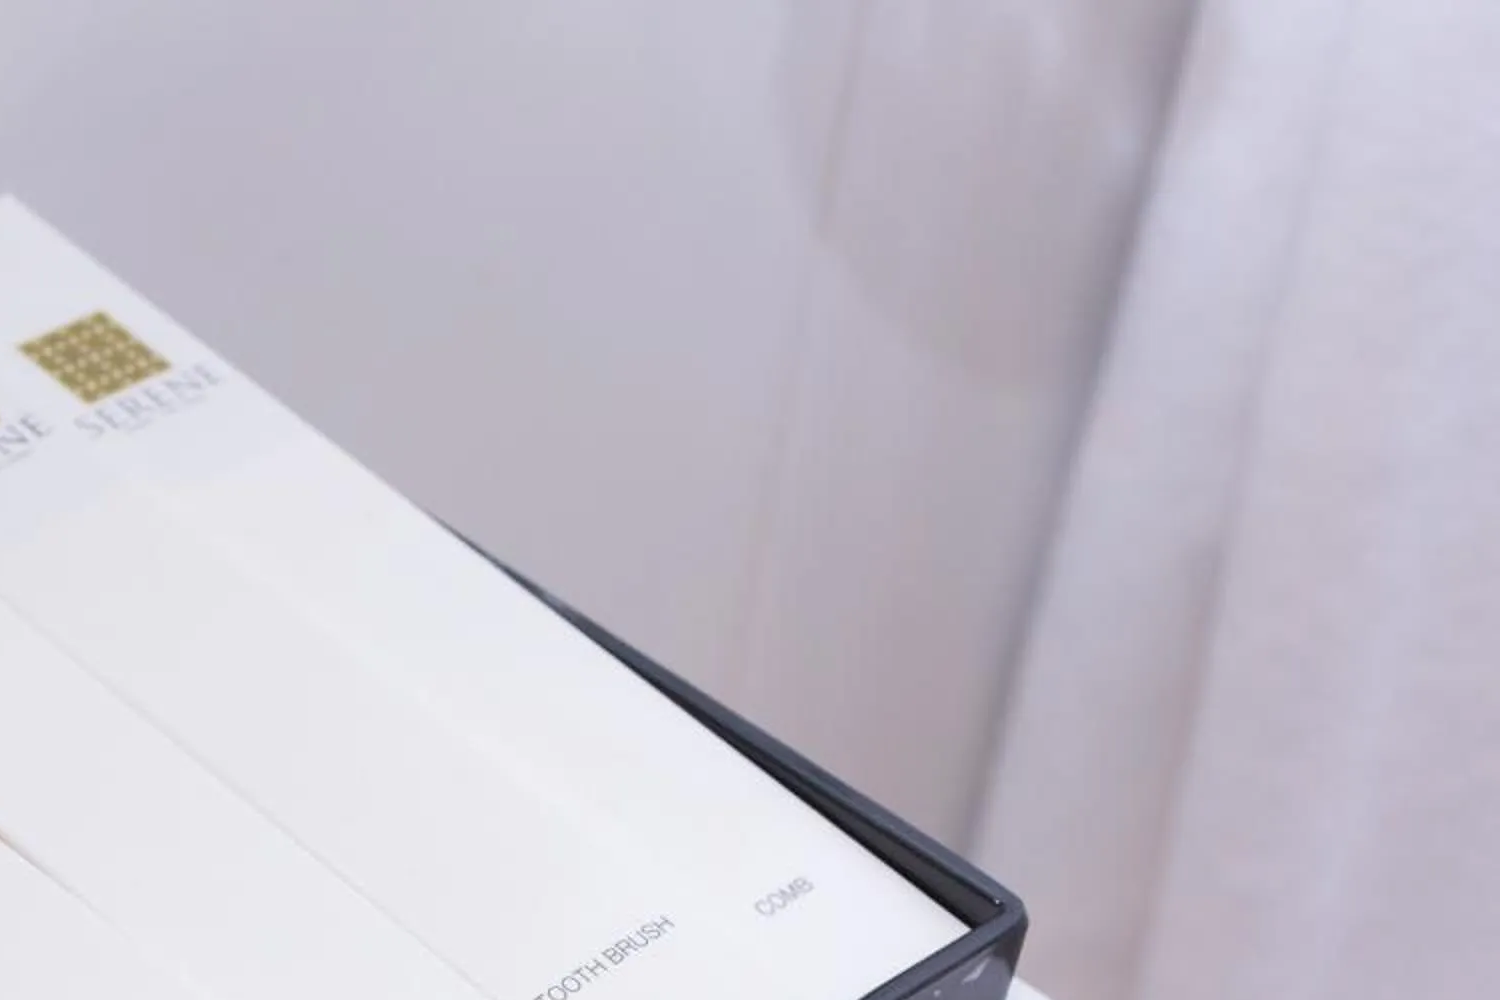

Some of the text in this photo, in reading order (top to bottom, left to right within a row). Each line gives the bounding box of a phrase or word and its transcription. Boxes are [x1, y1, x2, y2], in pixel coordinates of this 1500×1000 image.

[72, 363, 223, 441] SERENE
[754, 877, 814, 917] COMB
[601, 915, 675, 965] BRUSH
